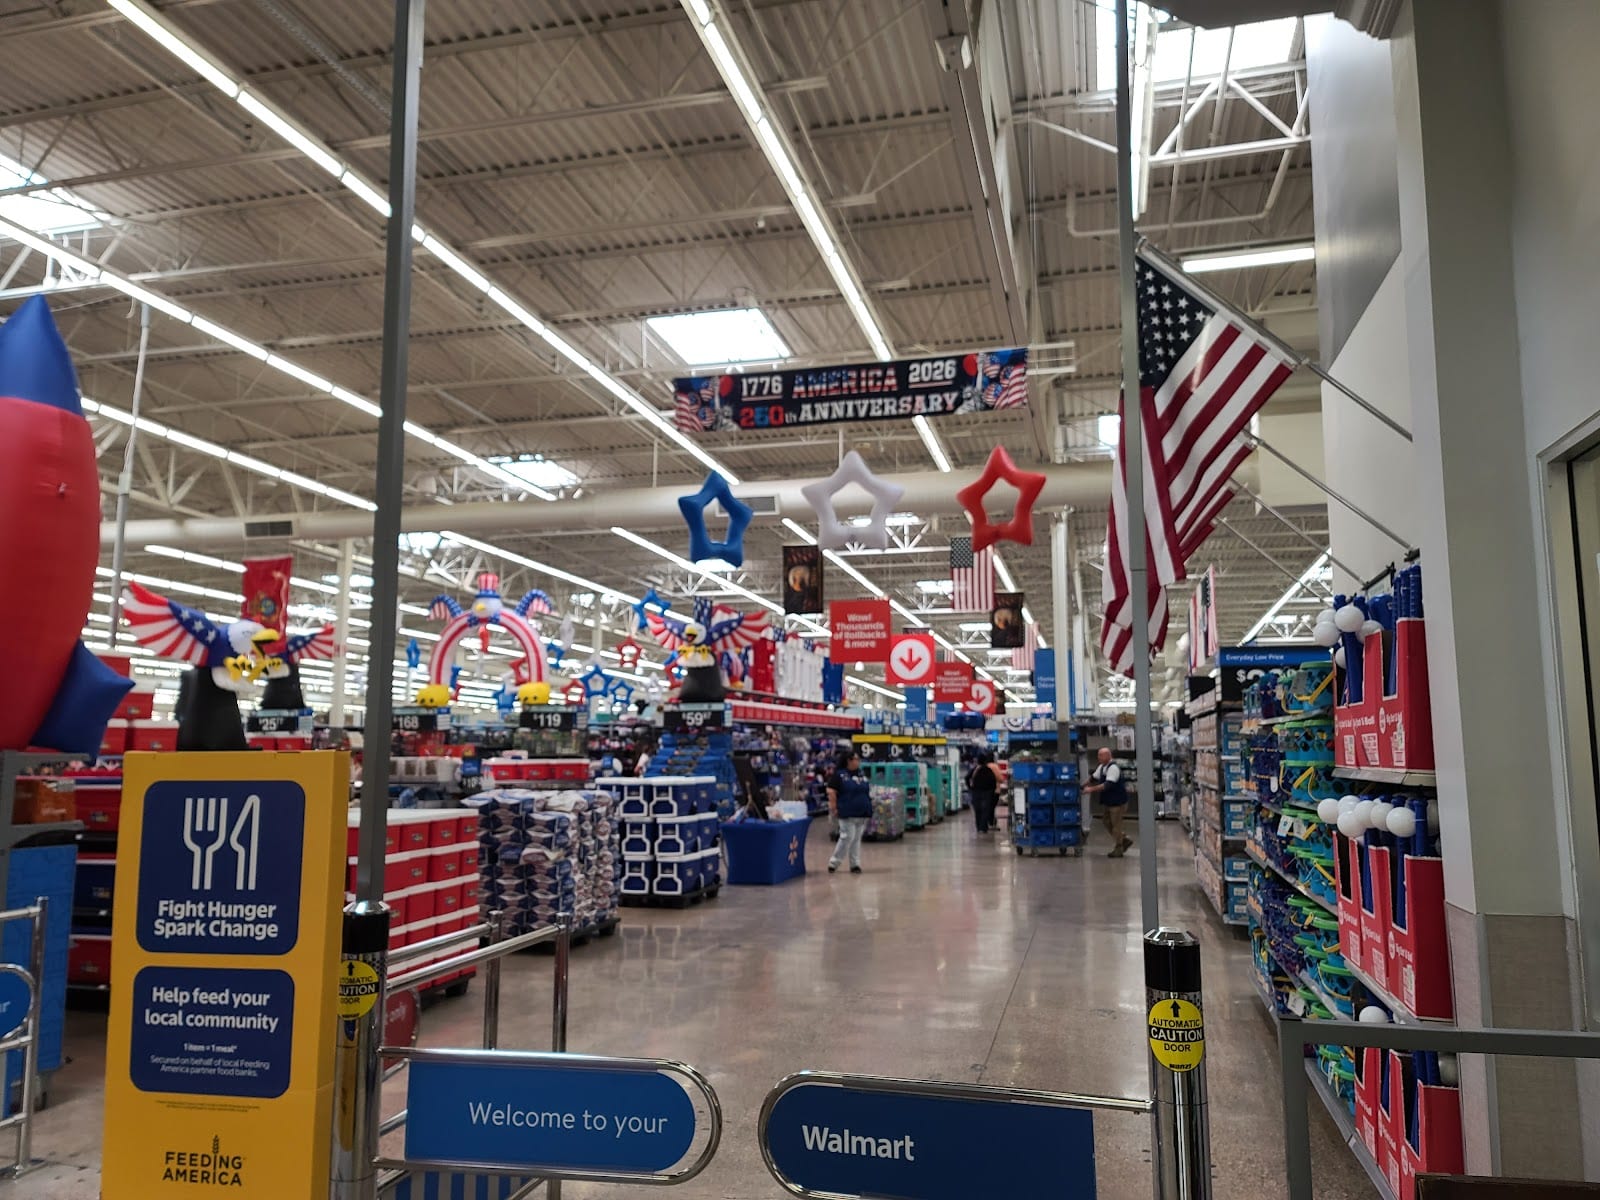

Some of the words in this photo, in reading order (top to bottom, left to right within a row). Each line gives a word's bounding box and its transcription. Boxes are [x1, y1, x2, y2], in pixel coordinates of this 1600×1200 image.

[741, 375, 783, 397] 1776
[791, 366, 898, 399] AMERICA
[908, 360, 957, 383] 2026
[798, 391, 960, 422] ANNIVERSARY
[835, 622, 884, 631] Thousands
[533, 713, 561, 727] $119
[158, 900, 205, 920] Fight
[207, 901, 277, 921] Hunger
[153, 919, 206, 939] Spark
[208, 919, 279, 941] Change
[152, 986, 190, 1006] Help
[192, 987, 230, 1005] feed
[232, 992, 271, 1008] your
[144, 1008, 184, 1026] local
[185, 1013, 279, 1034] community
[1152, 1017, 1200, 1028] AUTOMATIC
[1151, 1027, 1203, 1041] CAUTION
[184, 1043, 187, 1051] 1
[188, 1043, 205, 1052] item
[1164, 1043, 1191, 1052] DOOR
[150, 1055, 179, 1064] Secured
[190, 1057, 213, 1066] behalf
[222, 1059, 239, 1067] local
[240, 1059, 270, 1070] Feeding
[160, 1064, 189, 1073] America
[190, 1066, 216, 1074] partner
[217, 1067, 234, 1076] food
[469, 1102, 576, 1130] Welcome
[582, 1109, 607, 1131] to
[614, 1115, 668, 1139] your
[801, 1124, 915, 1161] Walmart
[165, 1151, 243, 1170] FEEDING
[162, 1168, 242, 1186] AMERICA
